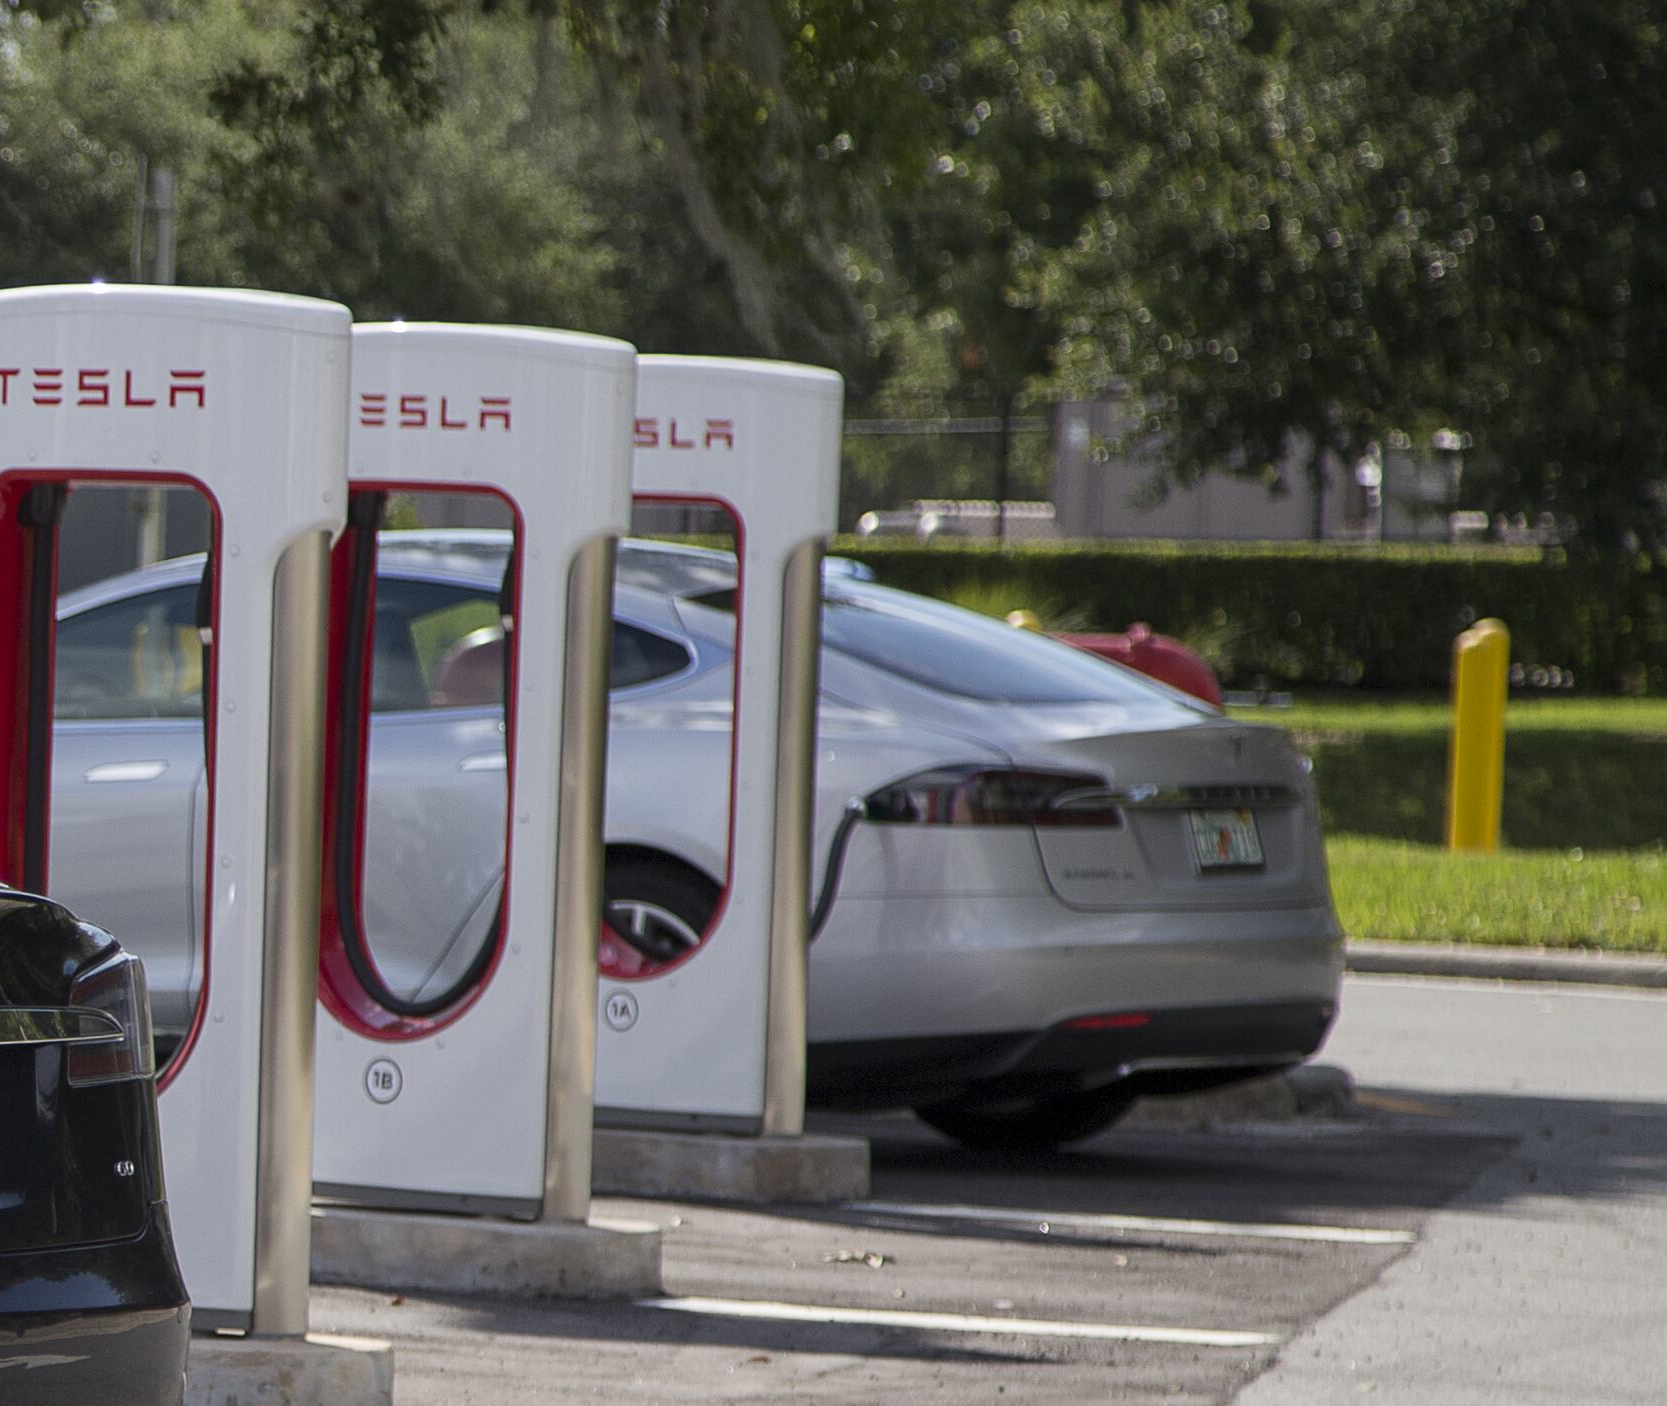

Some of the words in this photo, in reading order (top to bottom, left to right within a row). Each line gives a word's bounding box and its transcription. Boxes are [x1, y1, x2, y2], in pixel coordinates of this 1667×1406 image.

[360, 393, 511, 431] ESLA
[634, 418, 733, 449] SLA
[612, 1002, 632, 1021] 1A
[373, 1070, 394, 1090] 1B
